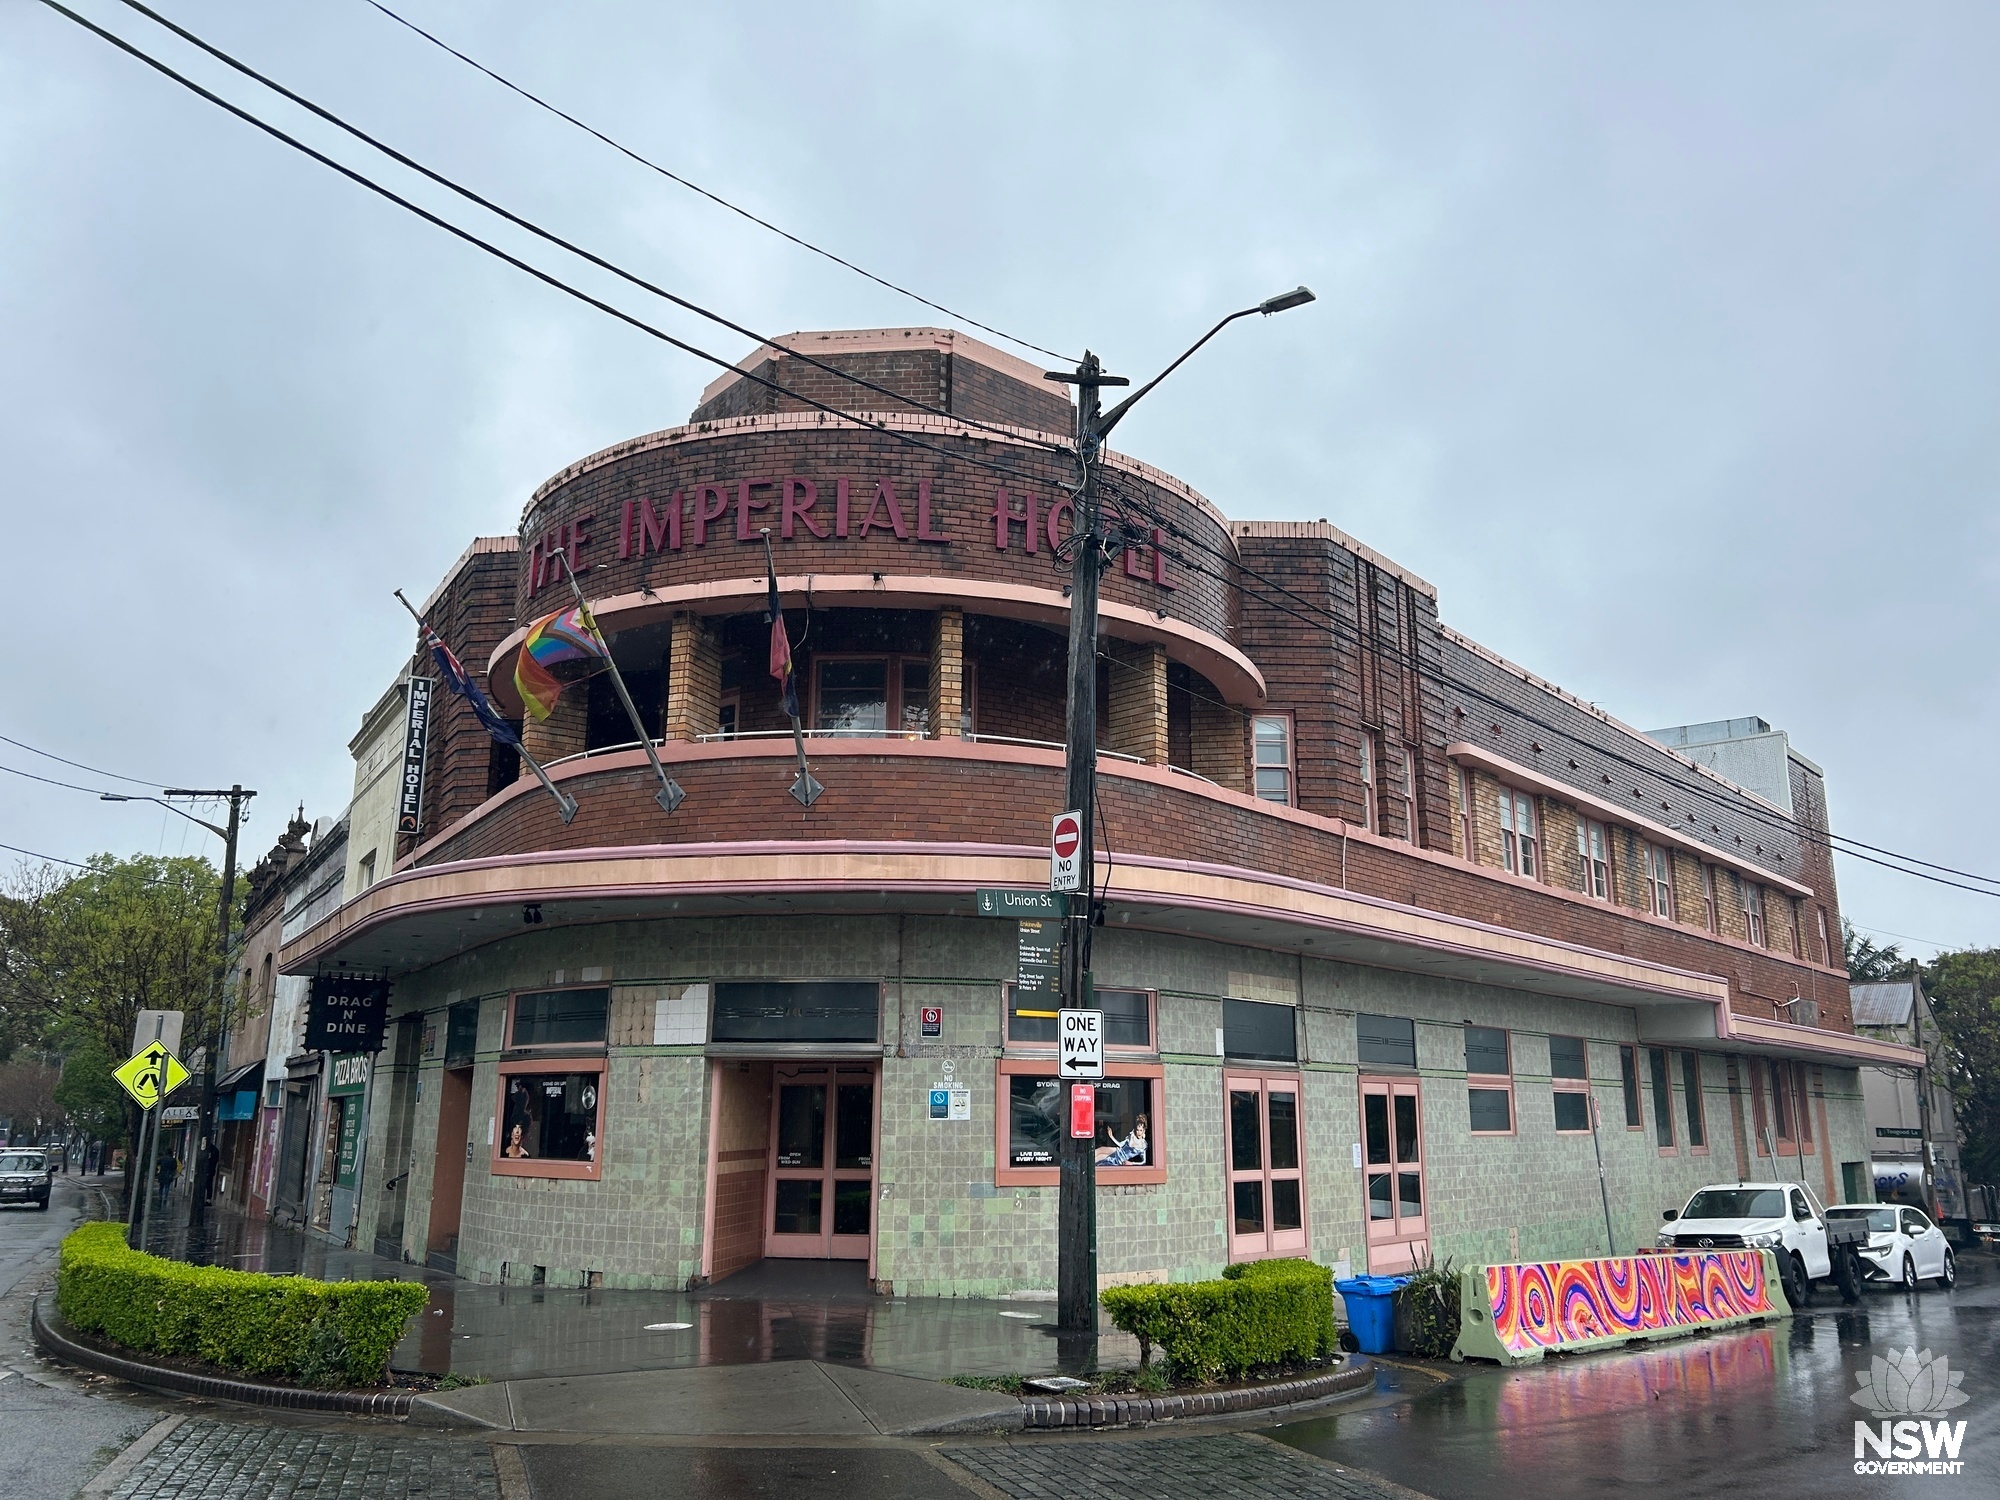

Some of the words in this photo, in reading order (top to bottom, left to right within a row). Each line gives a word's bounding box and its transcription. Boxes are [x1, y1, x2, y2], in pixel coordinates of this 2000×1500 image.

[527, 514, 596, 599] THE
[619, 477, 952, 559] IMPERIAL
[991, 488, 1180, 592] HOEL
[409, 681, 428, 758] IMPERIAL
[403, 764, 420, 814] HOTEL
[1058, 859, 1072, 873] NO
[1053, 874, 1076, 887] ENTRY
[1004, 893, 1038, 907] Union
[1040, 894, 1052, 907] St
[327, 995, 372, 1007] DRAG
[326, 1022, 366, 1034] DINE
[1066, 1016, 1096, 1032] ONE
[1064, 1037, 1098, 1053] WAY
[334, 1058, 350, 1086] PIZZA
[350, 1055, 368, 1084] BROS
[933, 1081, 964, 1089] SMOKING
[943, 1074, 953, 1082] NO
